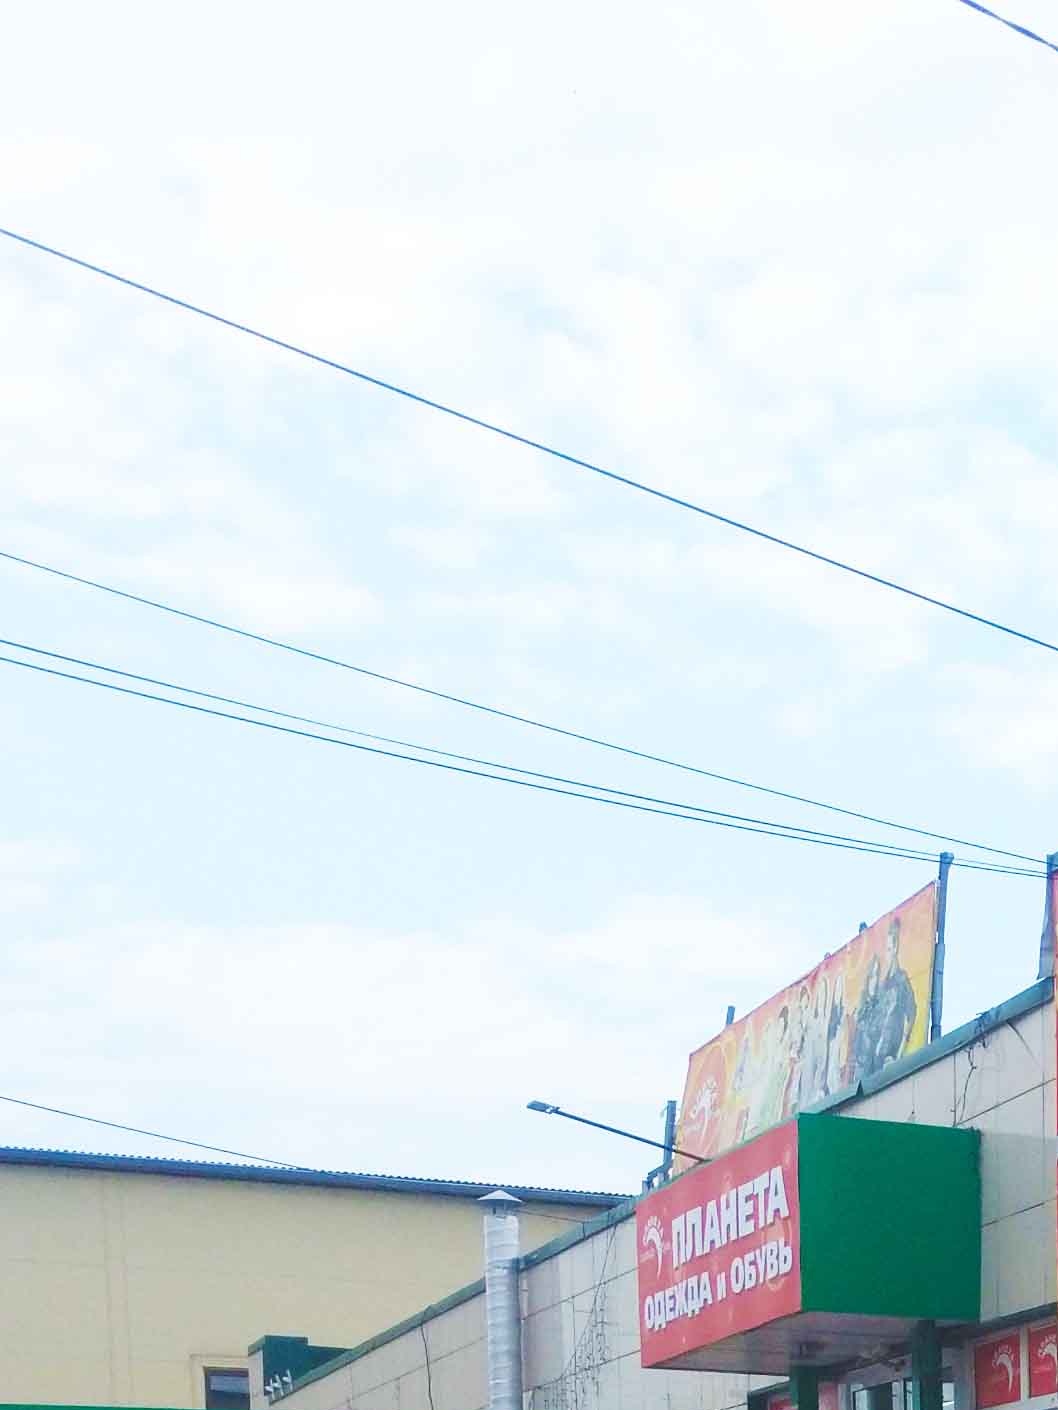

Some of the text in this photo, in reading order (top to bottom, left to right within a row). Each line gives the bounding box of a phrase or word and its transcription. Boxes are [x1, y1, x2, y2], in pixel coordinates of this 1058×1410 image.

[672, 1165, 789, 1270] ПЛАНЕТА
[644, 1237, 793, 1331] ОДЕЖДА и ОБУВЬ
